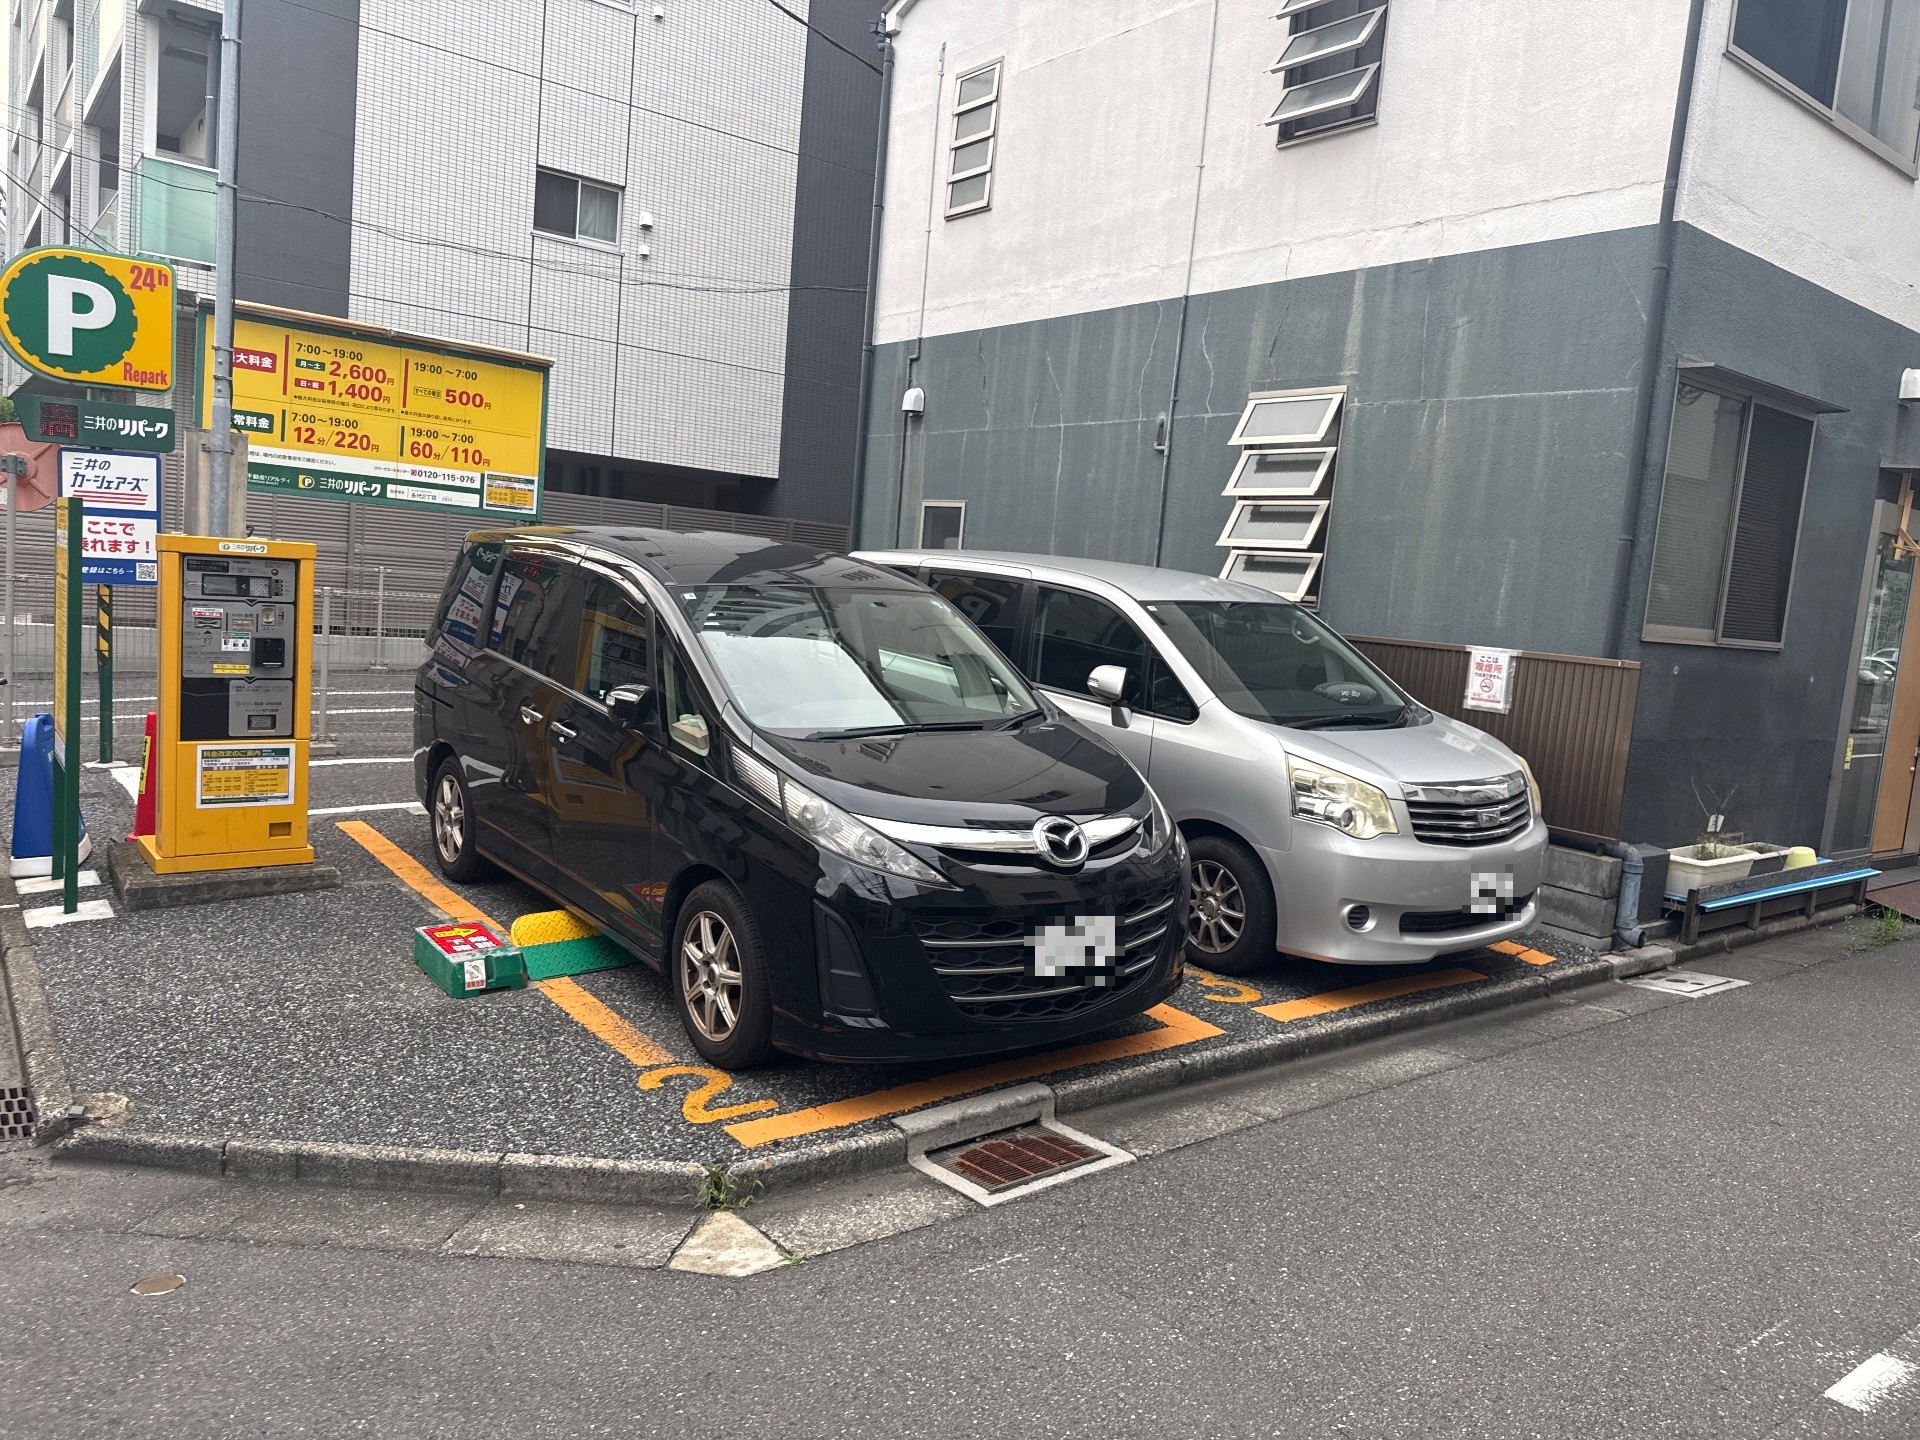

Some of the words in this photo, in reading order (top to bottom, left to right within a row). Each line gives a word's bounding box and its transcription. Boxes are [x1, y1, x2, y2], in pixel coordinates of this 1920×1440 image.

[130, 265, 168, 292] 24h
[47, 274, 116, 356] P
[233, 352, 273, 368] 大料金
[123, 362, 168, 385] Repark
[329, 360, 395, 385] 2,600円
[328, 380, 391, 404] 1,400円
[445, 388, 492, 410] 500円
[84, 415, 168, 438] 三井のリパーク
[230, 413, 270, 429] 常料金
[70, 457, 111, 471] 三井の
[70, 472, 148, 492] カーシェアーズ
[319, 477, 381, 496] 三井のリパーク
[417, 469, 475, 484] 0120-115-076
[87, 521, 136, 536] ここで
[1475, 662, 1503, 674] 喫煙所
[1480, 655, 1499, 663] ここは
[637, 1065, 779, 1124] 2
